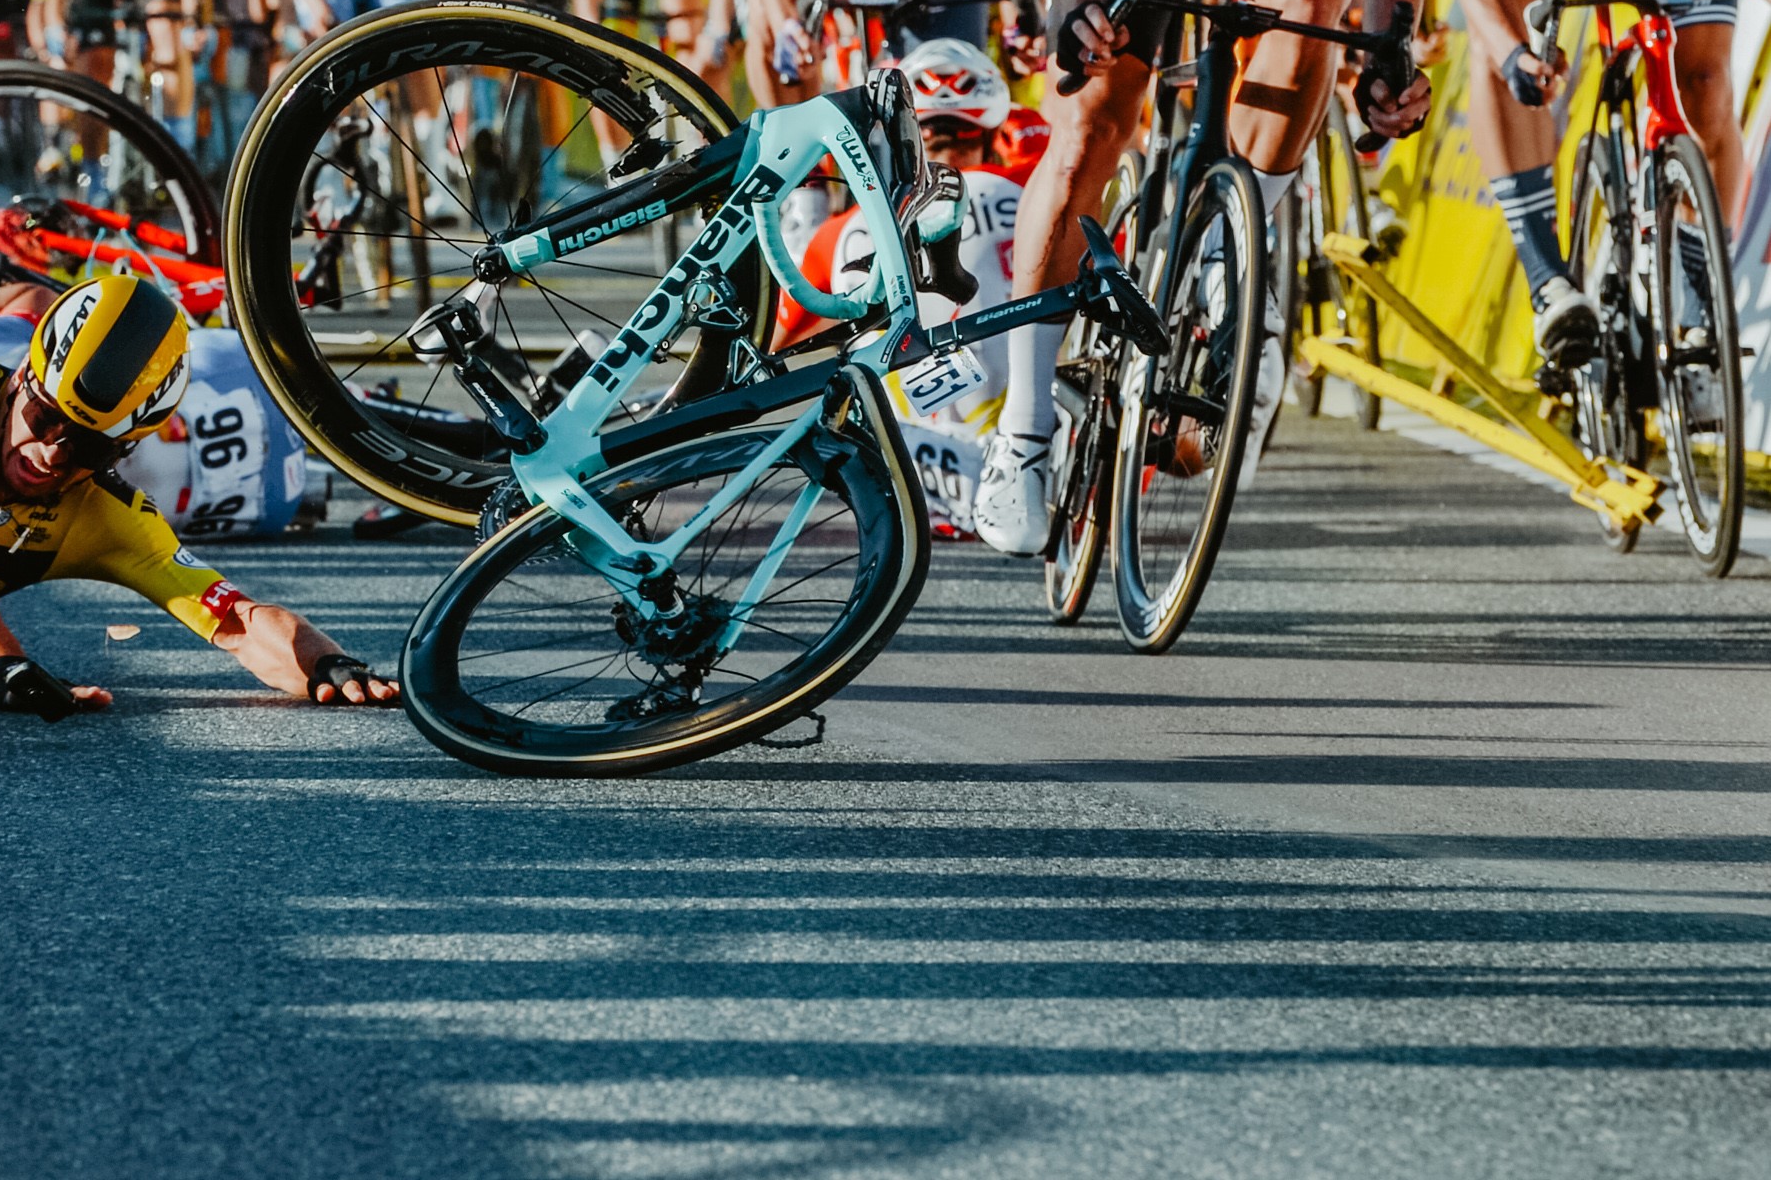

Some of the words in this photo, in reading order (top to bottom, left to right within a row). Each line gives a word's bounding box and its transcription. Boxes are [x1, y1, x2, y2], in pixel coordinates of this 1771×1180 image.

[558, 199, 668, 255] Bianchi
[587, 164, 786, 394] Bianchi
[51, 295, 97, 374] LAZER
[976, 297, 1042, 325] Bianchi
[63, 400, 98, 426] LAZER
[131, 356, 185, 428] LAZER
[905, 358, 969, 411] 151
[195, 407, 248, 469] 96
